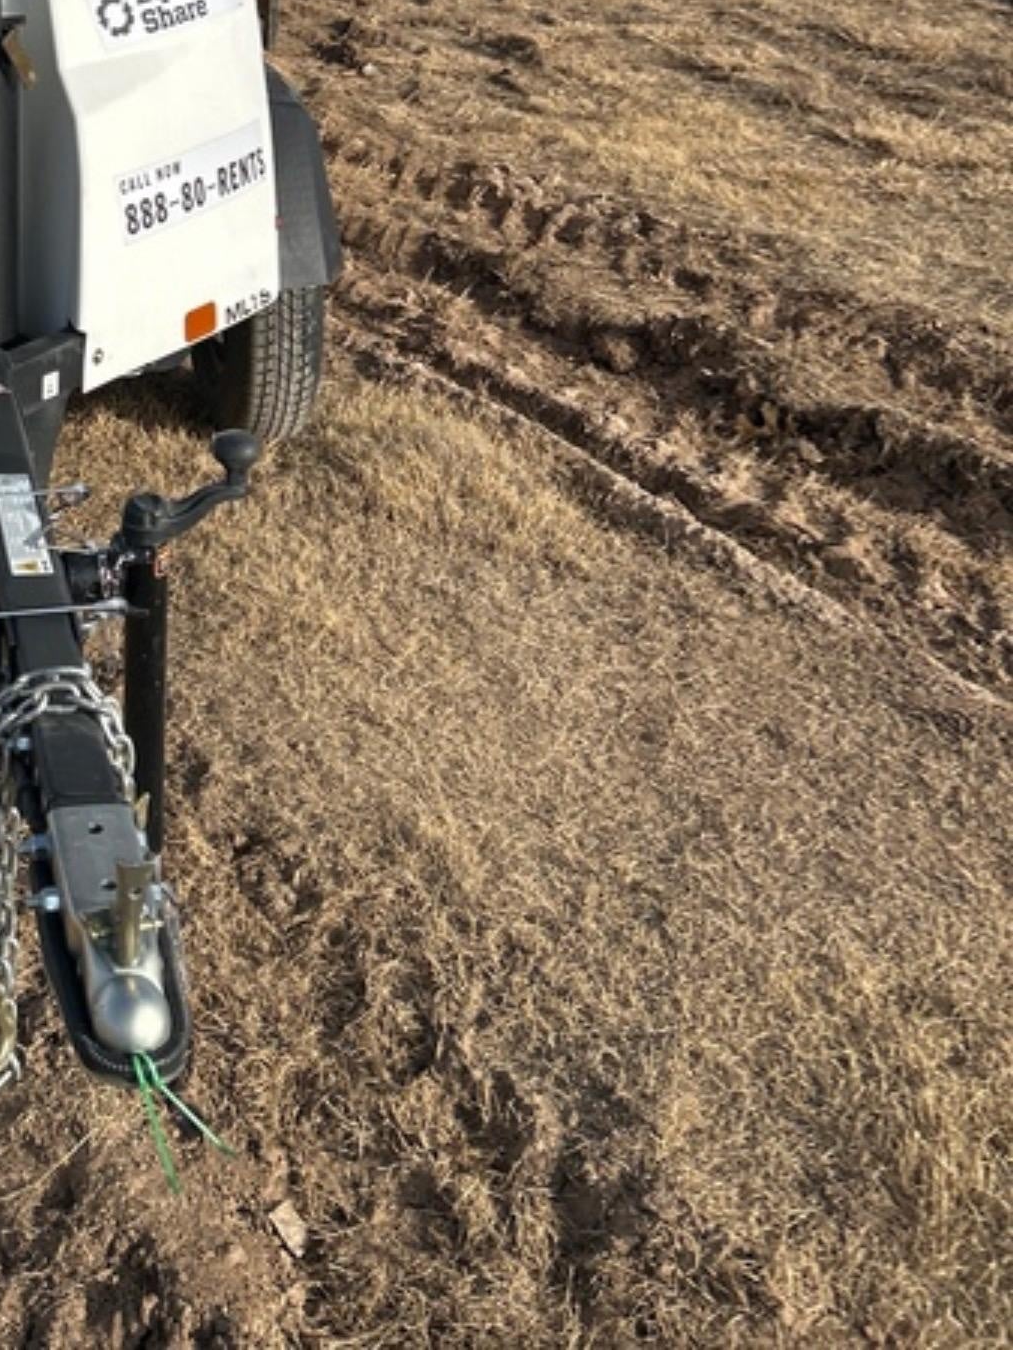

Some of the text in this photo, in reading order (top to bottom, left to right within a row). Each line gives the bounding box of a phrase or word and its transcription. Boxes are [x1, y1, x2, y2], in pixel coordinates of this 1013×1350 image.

[140, 0, 207, 34] Share
[119, 161, 181, 195] CALL NOW
[125, 147, 266, 235] 888-80-RENTS
